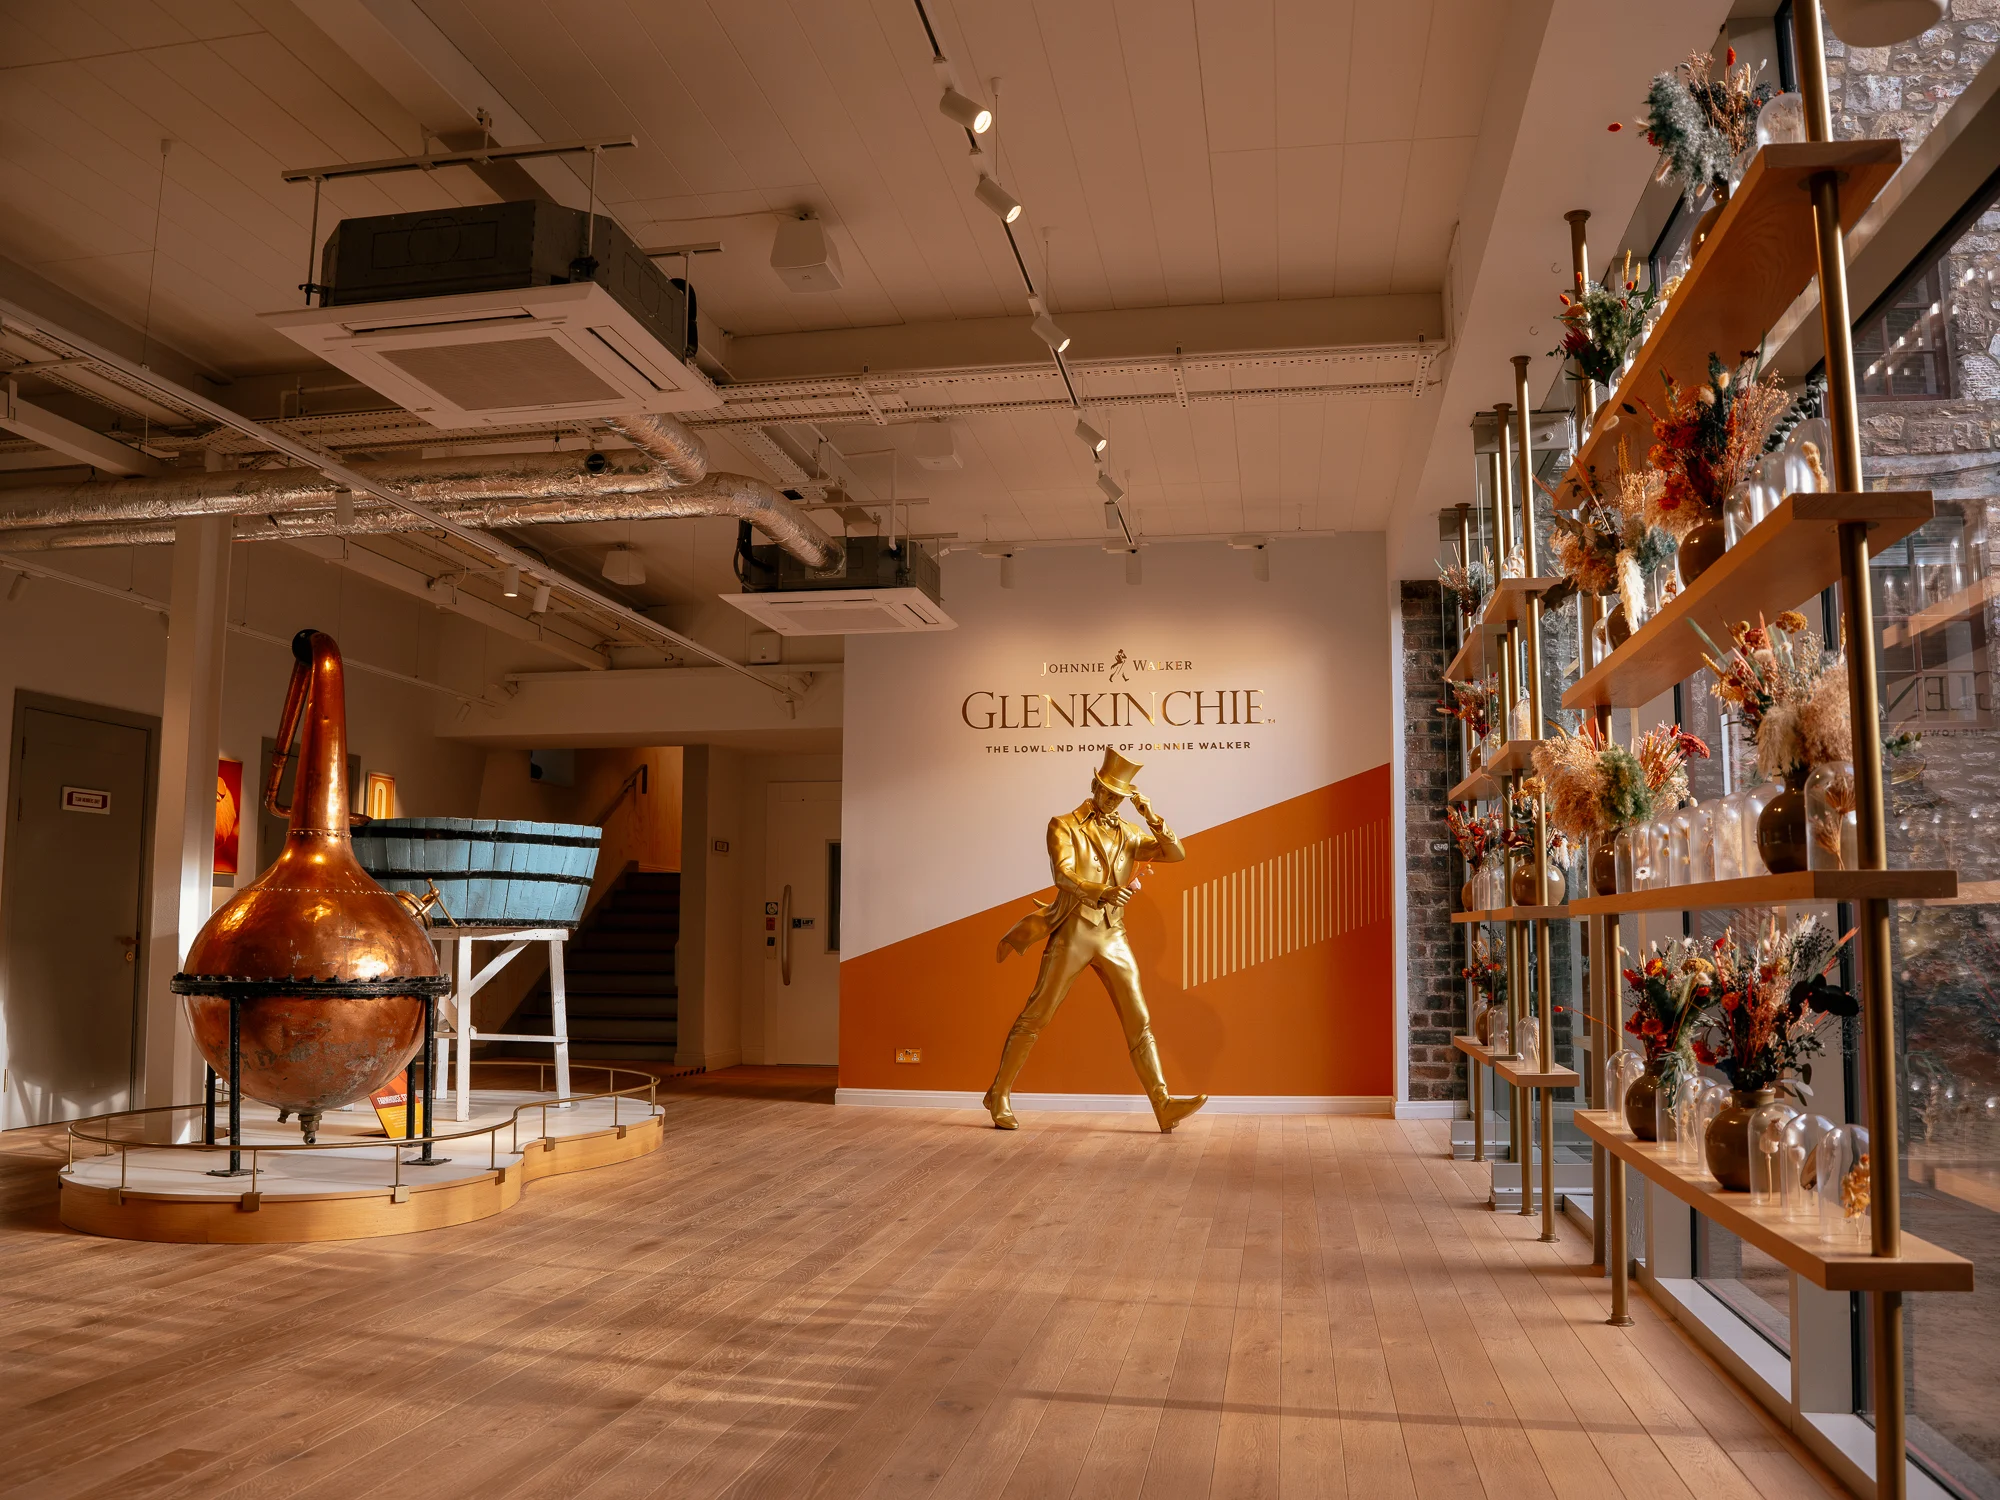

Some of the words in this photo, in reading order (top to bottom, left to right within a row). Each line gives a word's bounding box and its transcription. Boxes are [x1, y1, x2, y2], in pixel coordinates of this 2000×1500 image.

[1040, 662, 1105, 677] JOHNNIE
[1133, 659, 1193, 672] WALKER
[961, 689, 1265, 729] GLENKINCHIE
[985, 745, 1010, 754] THE
[1014, 744, 1074, 753] LOWLAND
[1119, 743, 1134, 751] OF
[1138, 742, 1194, 751] JOHNNIE
[1199, 741, 1251, 750] WALKER
